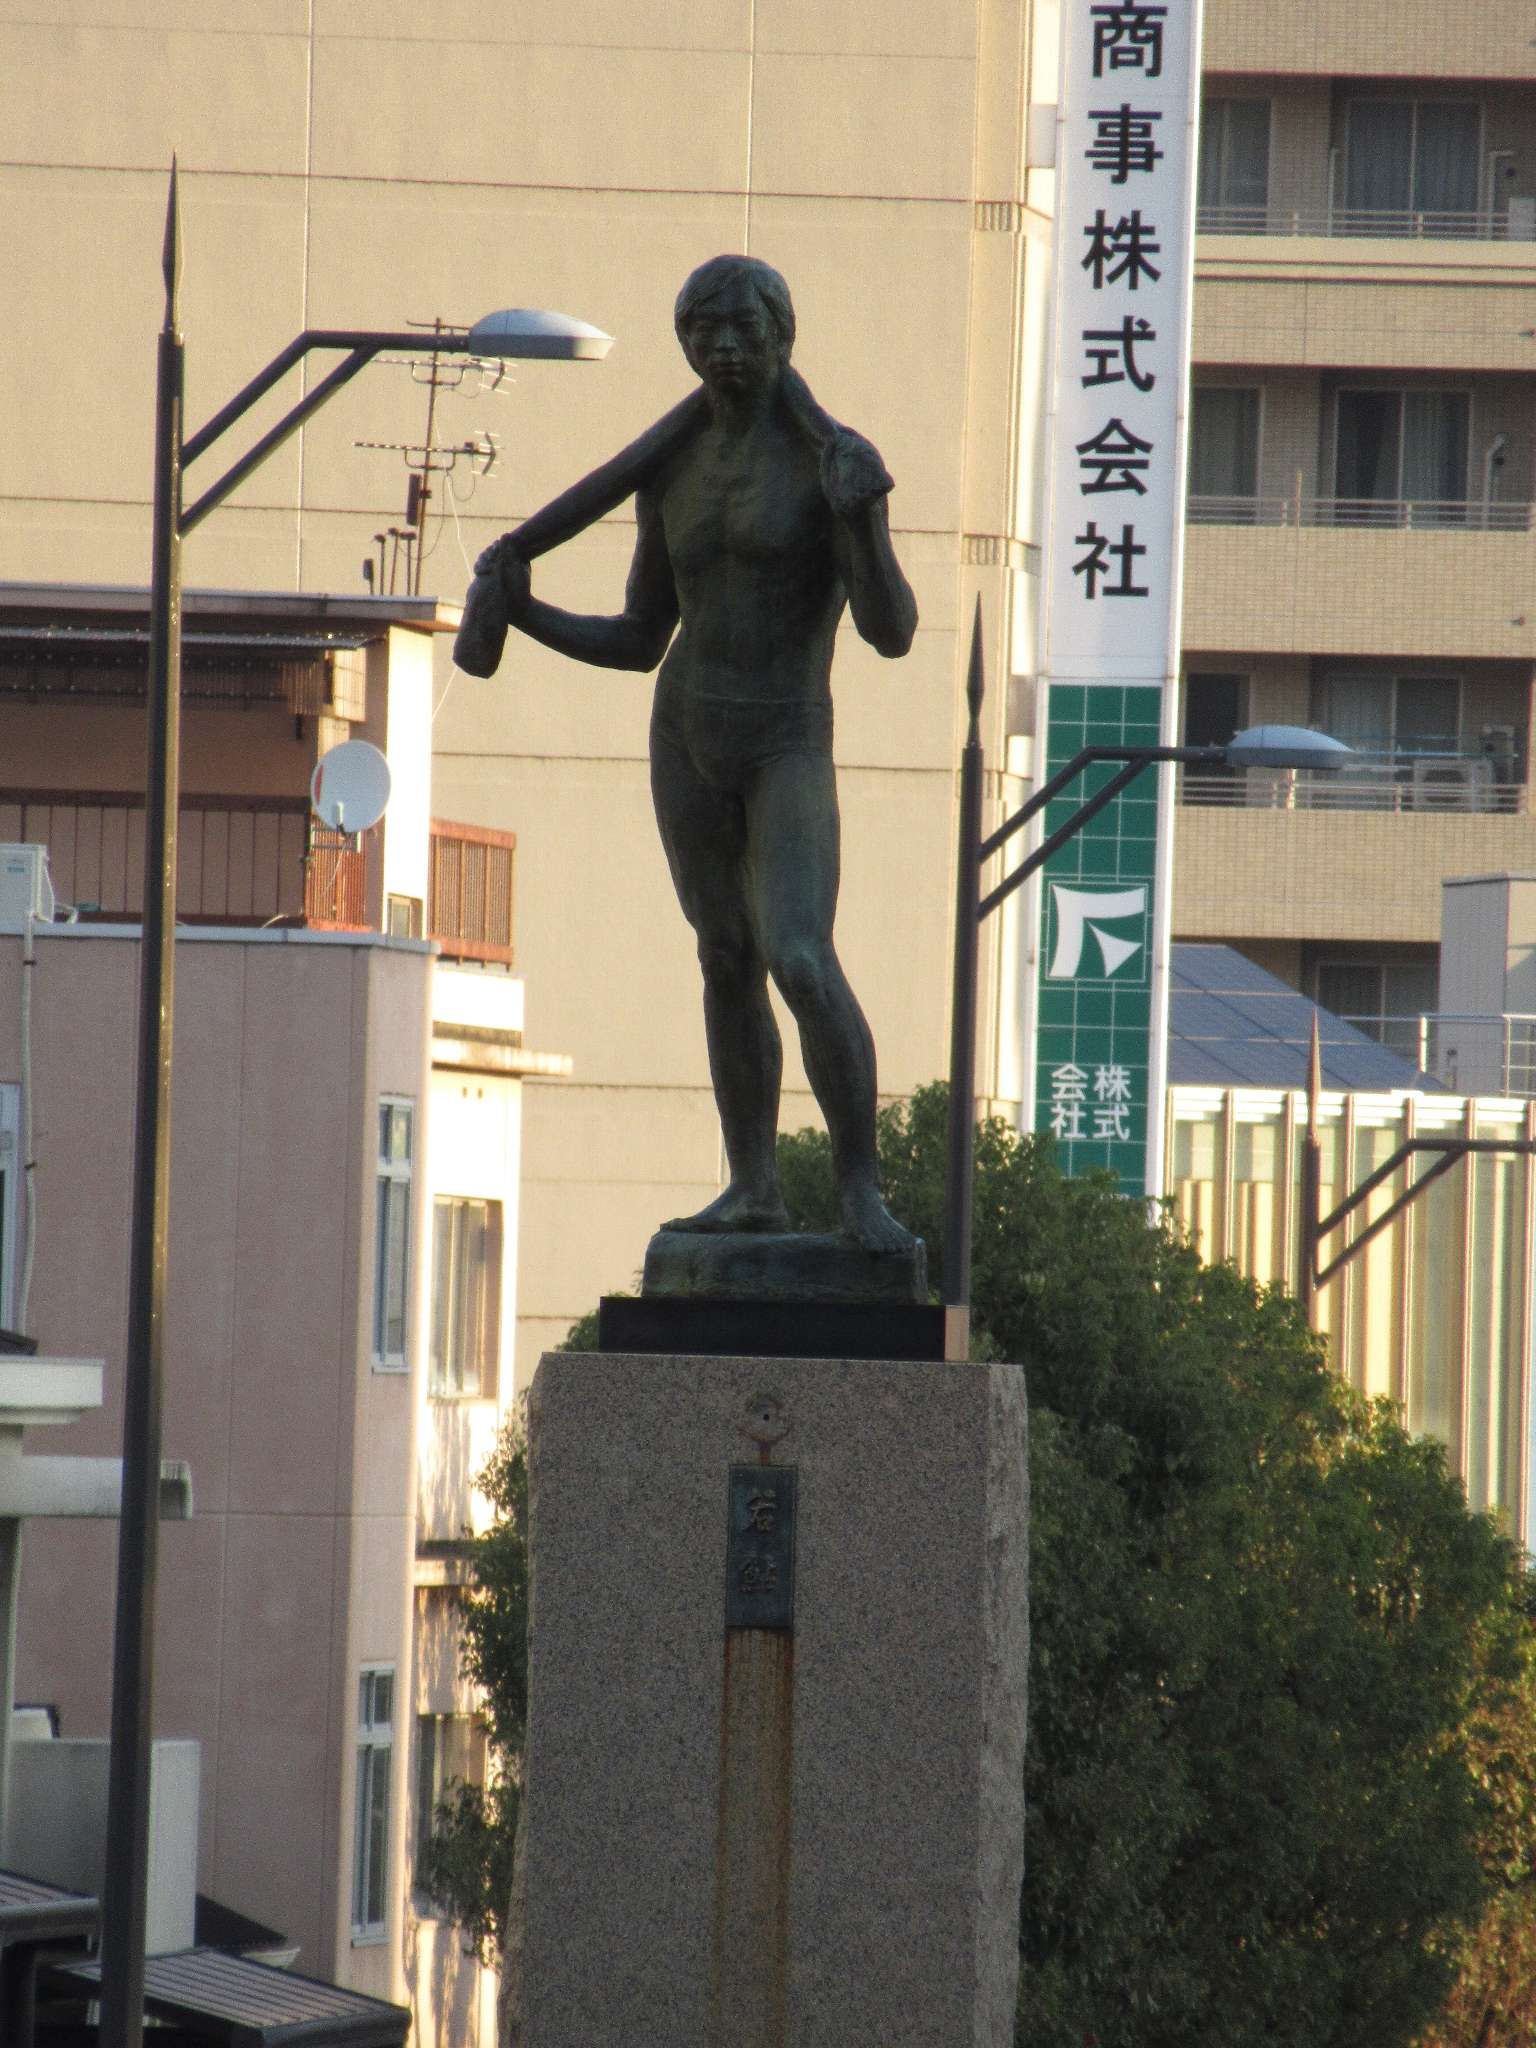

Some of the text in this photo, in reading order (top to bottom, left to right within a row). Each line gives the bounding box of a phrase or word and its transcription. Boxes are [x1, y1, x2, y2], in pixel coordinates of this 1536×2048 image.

[1072, 0, 1168, 600] 商事株式会社
